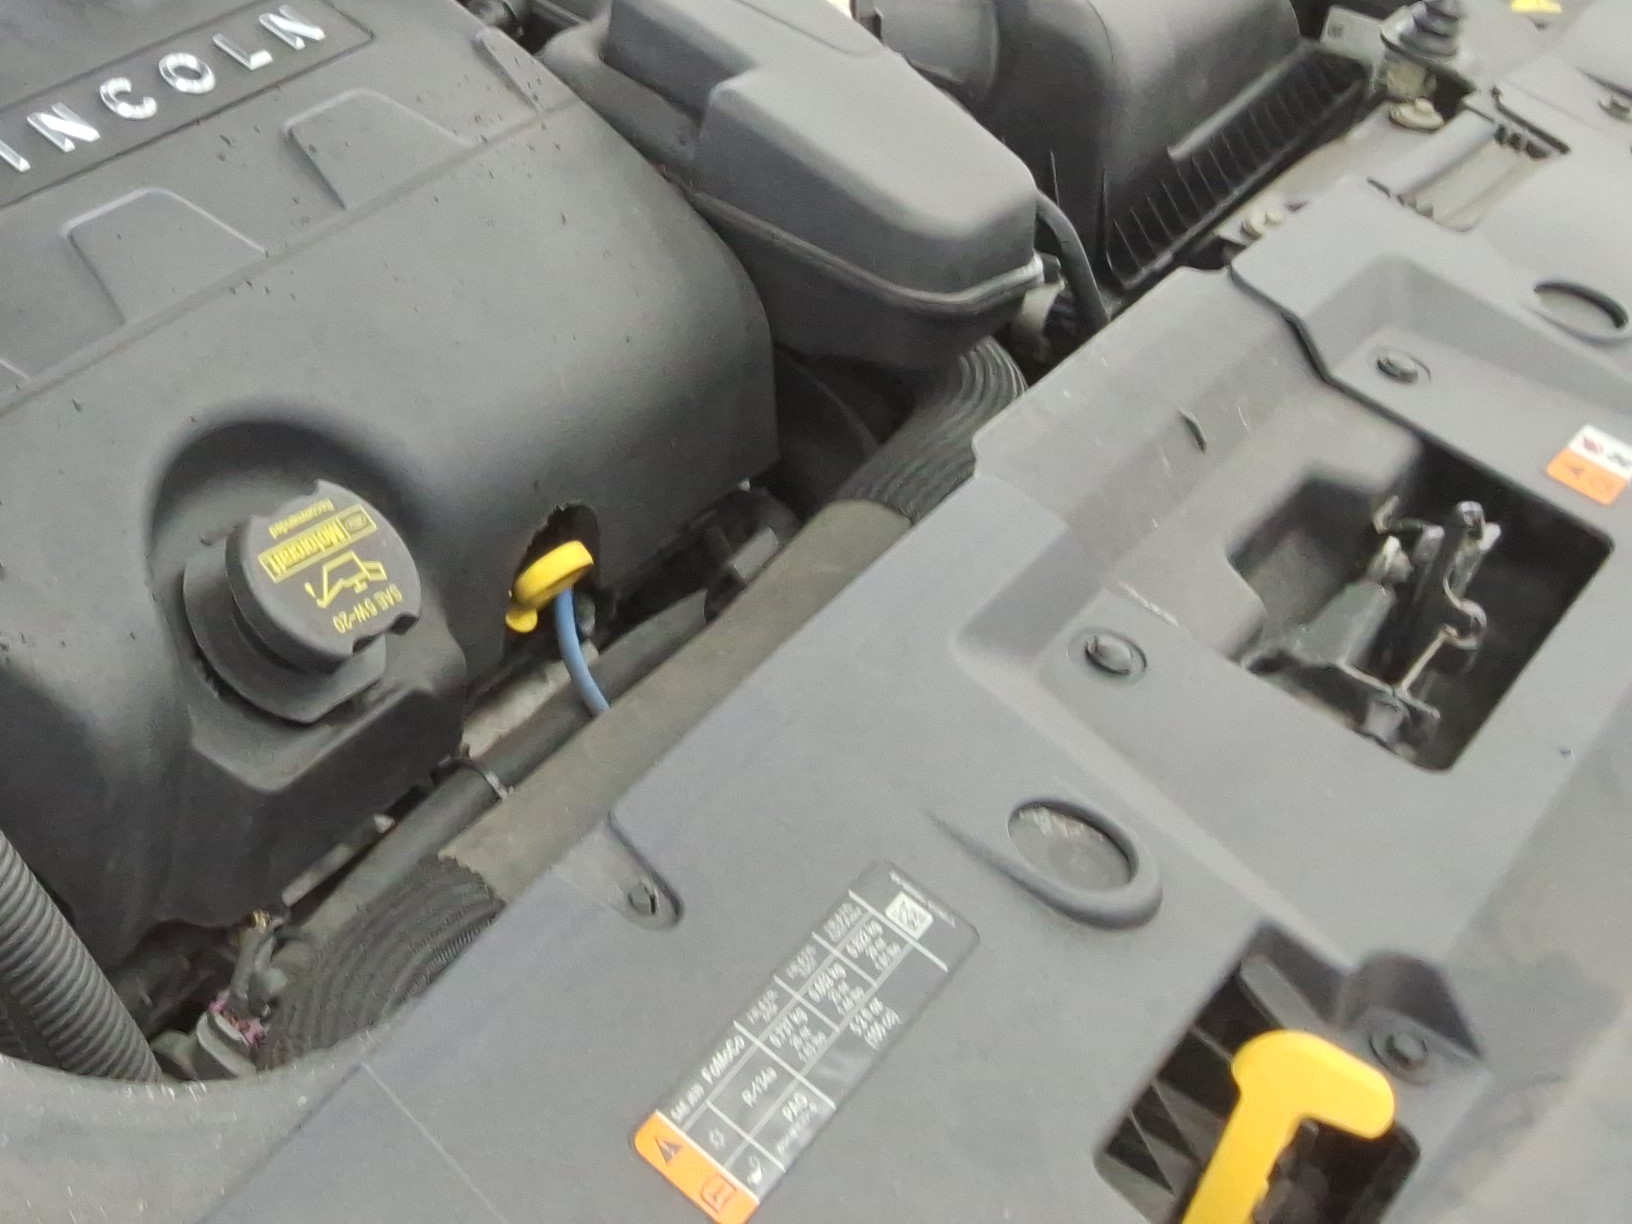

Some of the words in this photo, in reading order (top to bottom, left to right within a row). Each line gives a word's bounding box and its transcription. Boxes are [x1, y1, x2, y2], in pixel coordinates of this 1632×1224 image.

[268, 517, 347, 576] Motorcraft
[332, 597, 378, 634] 5W-20
[373, 583, 403, 611] SAE
